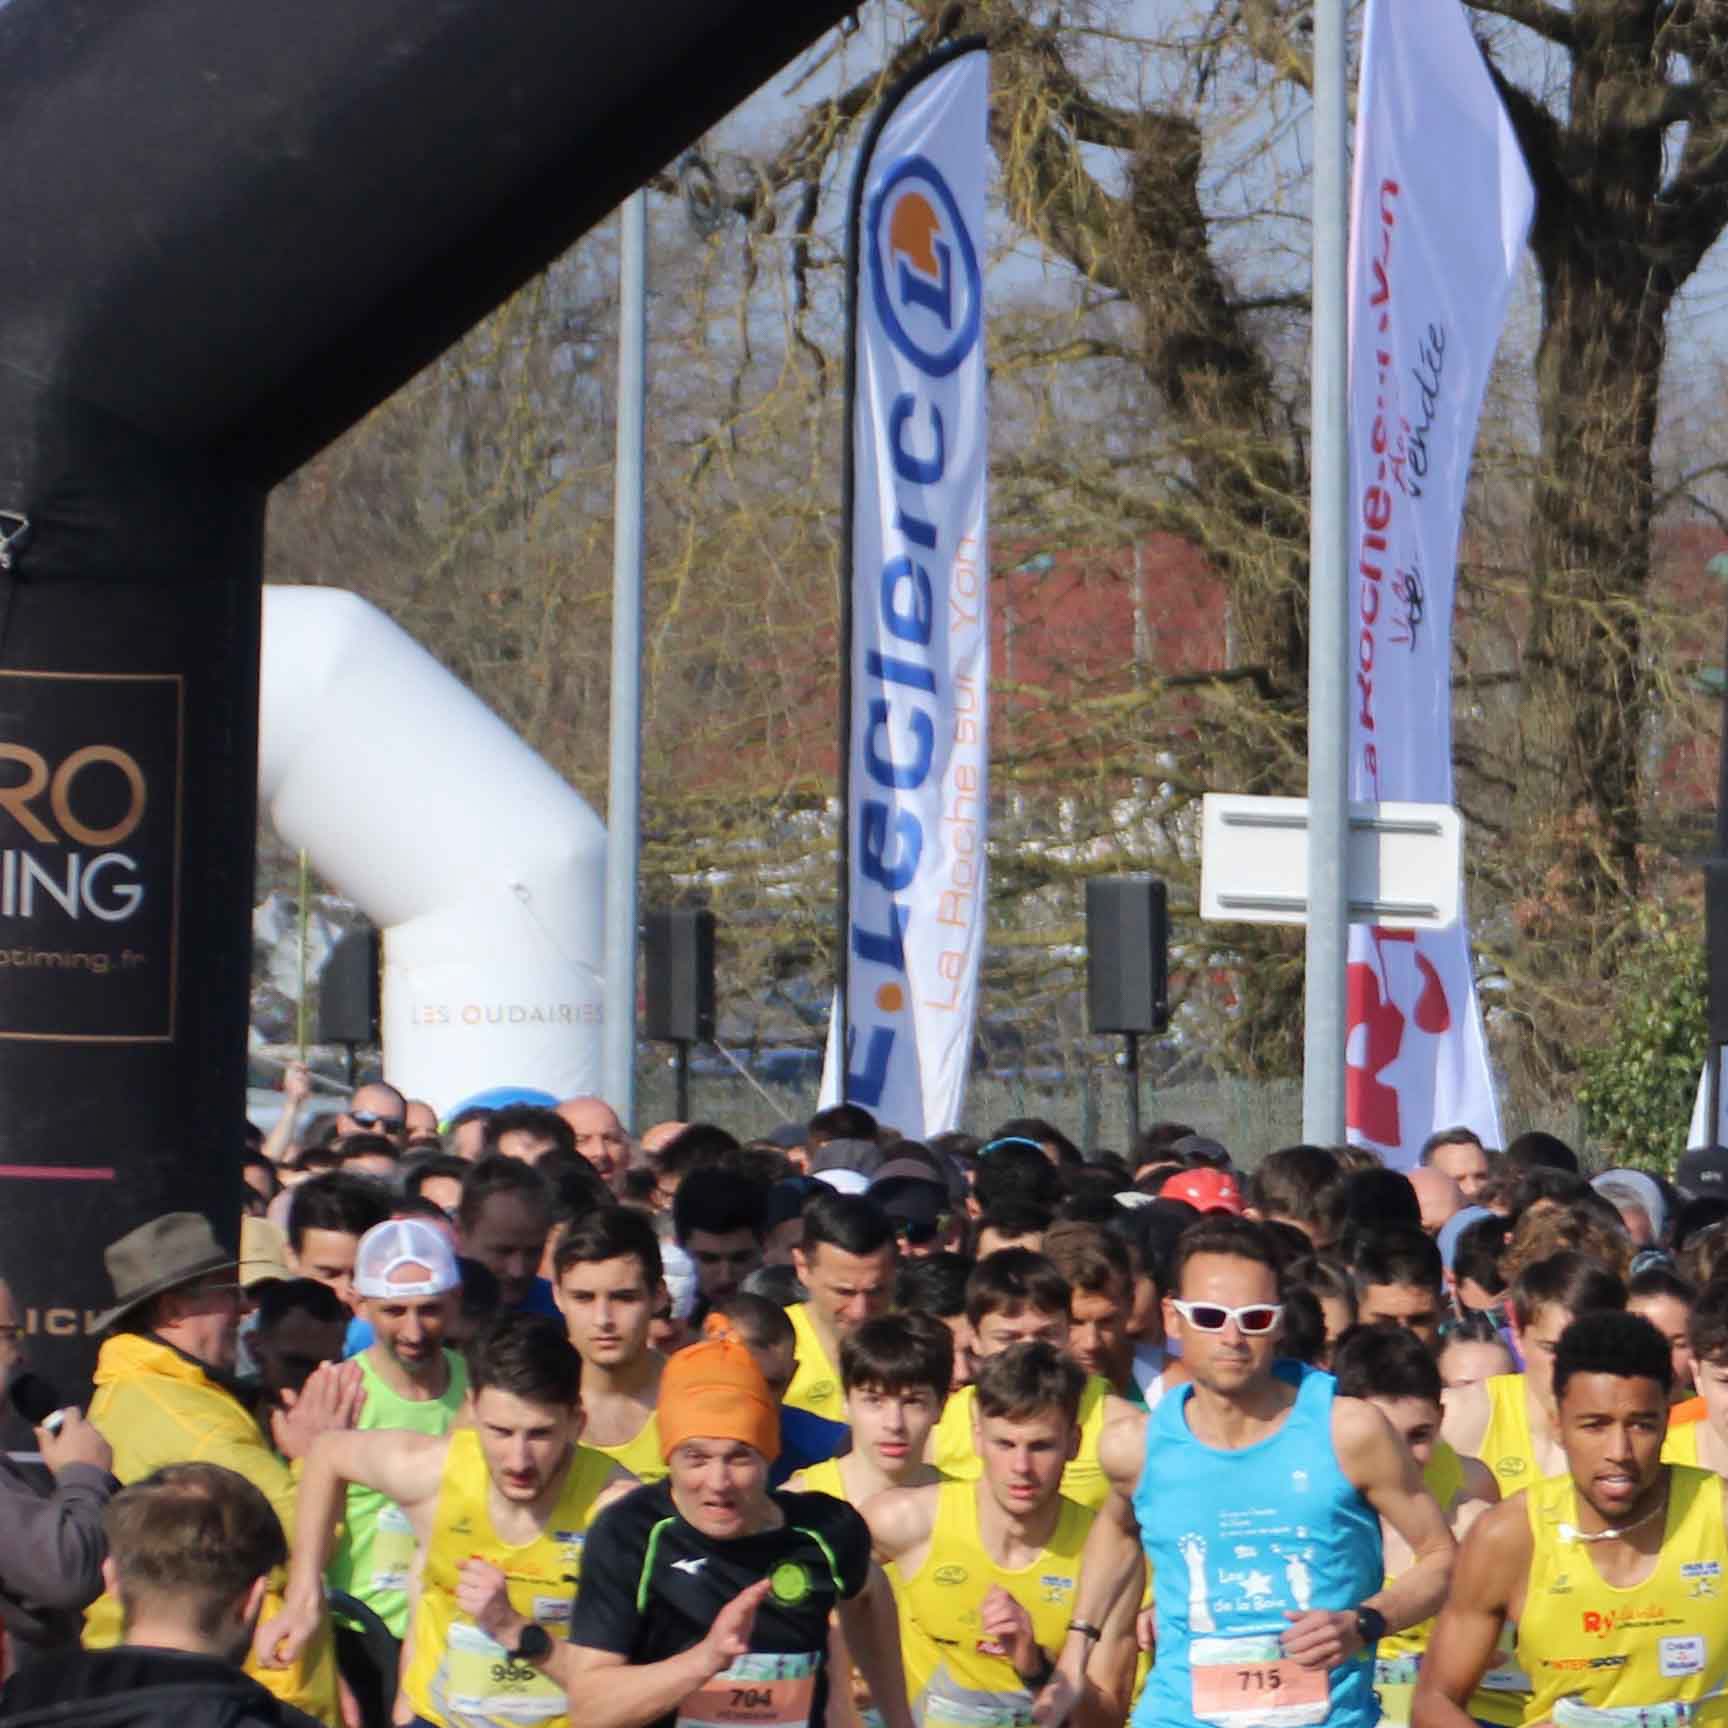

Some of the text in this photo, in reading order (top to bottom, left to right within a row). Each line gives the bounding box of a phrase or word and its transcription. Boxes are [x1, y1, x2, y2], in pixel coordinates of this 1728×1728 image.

[925, 535, 979, 1012] La Roche sur Yon
[1237, 1668, 1282, 1691] 715
[731, 1687, 773, 1708] 704
